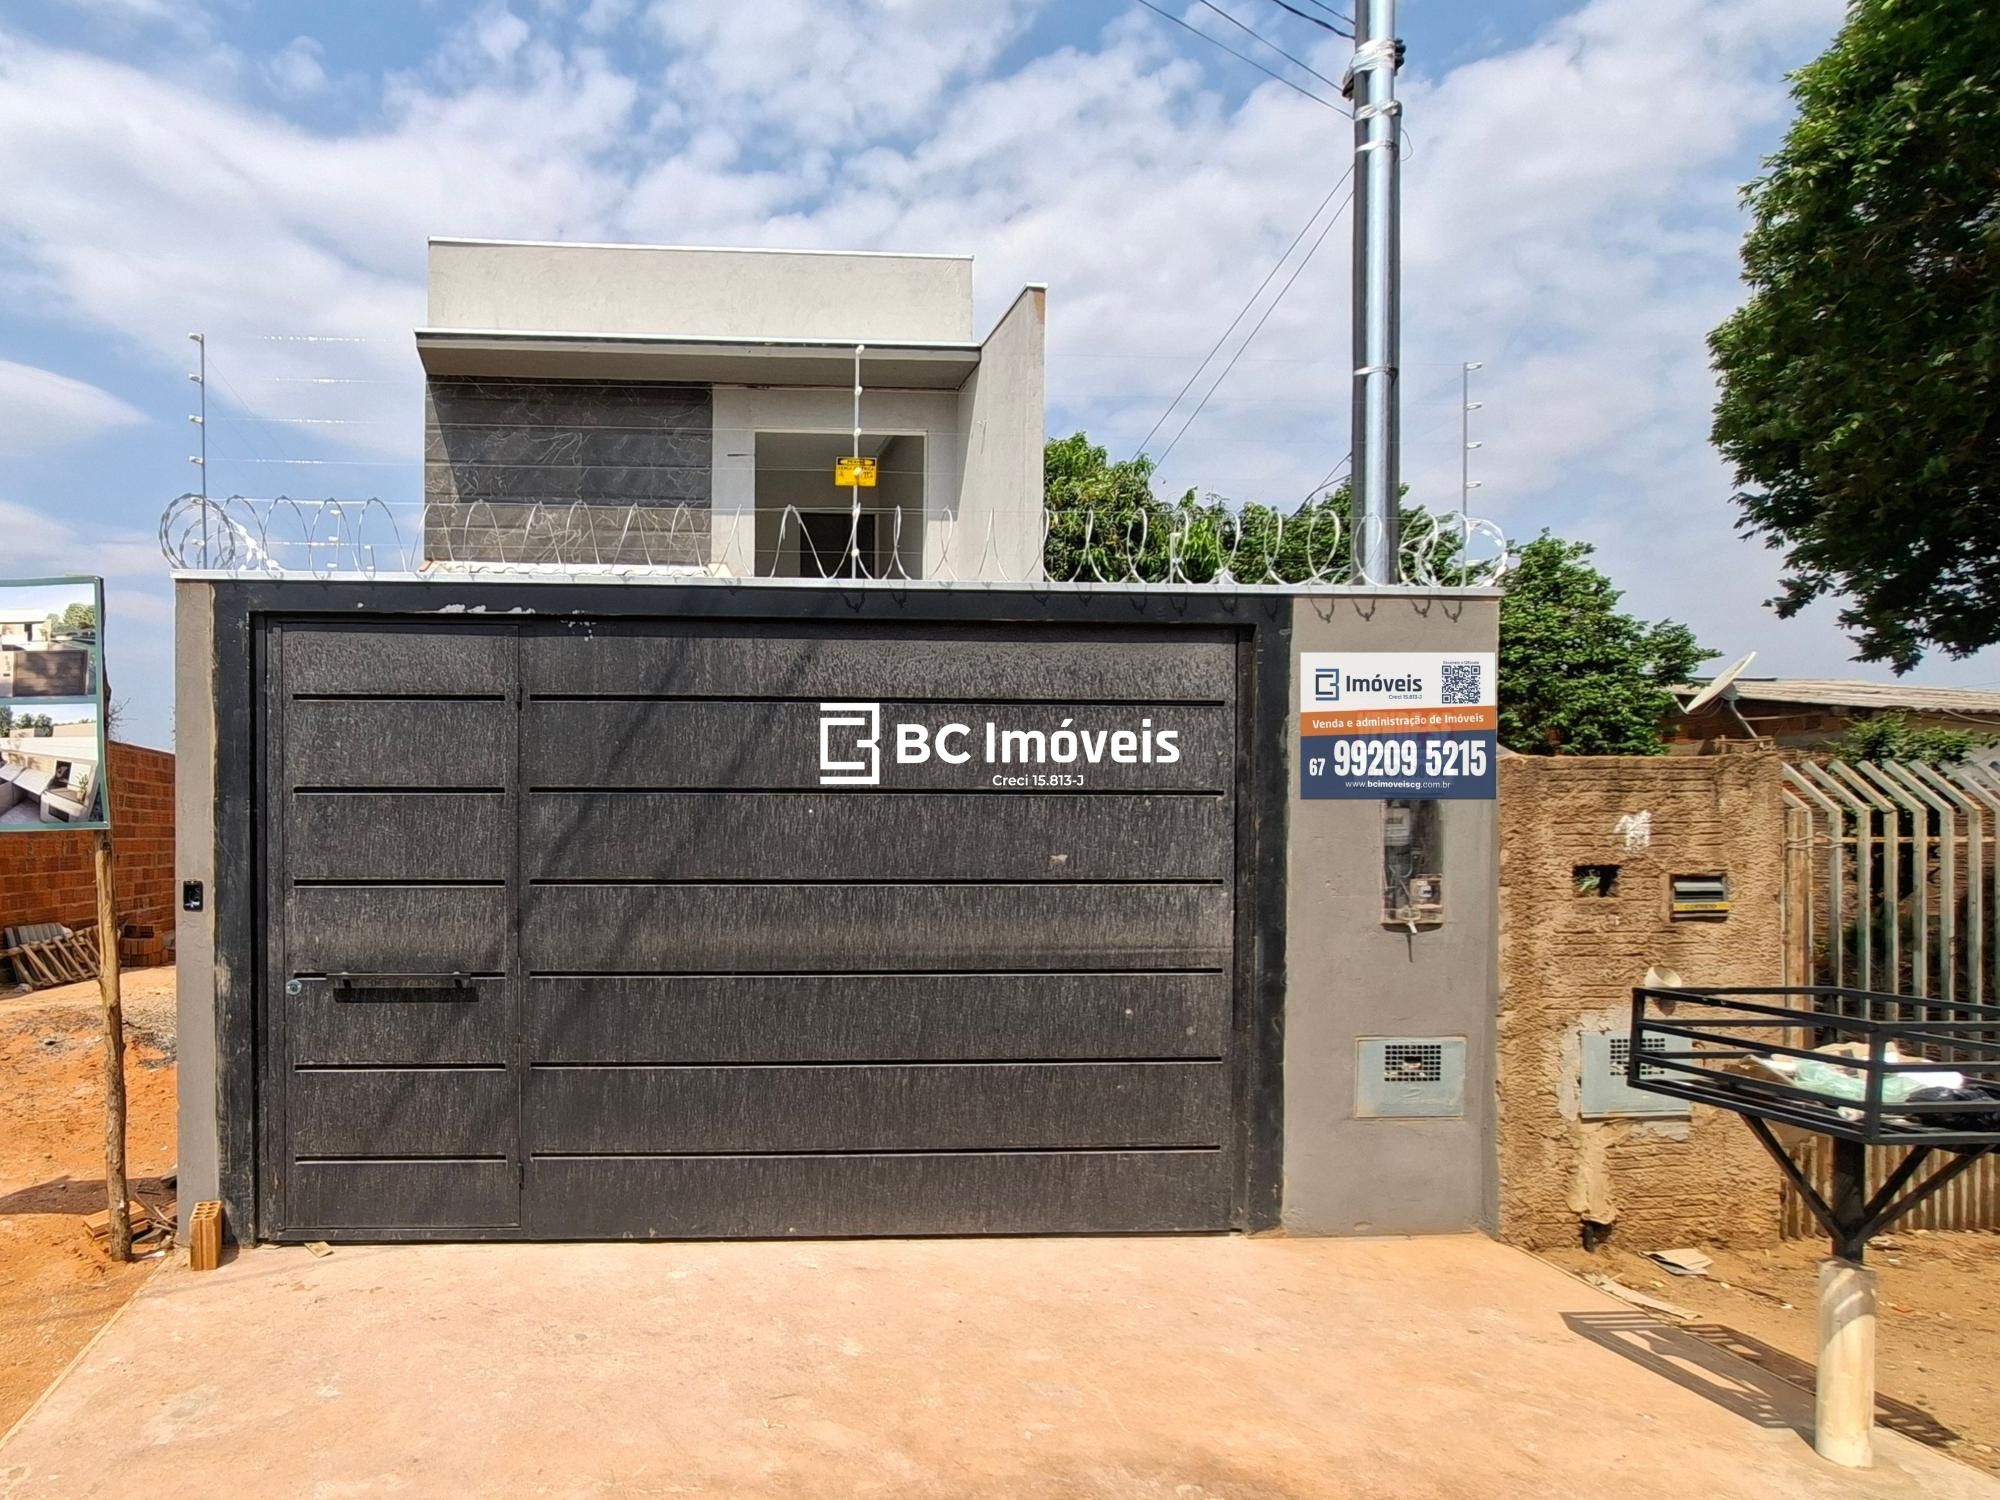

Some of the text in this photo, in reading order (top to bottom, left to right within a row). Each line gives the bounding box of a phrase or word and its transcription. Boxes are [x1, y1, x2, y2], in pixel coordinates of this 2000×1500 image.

[1346, 673, 1423, 692] Imóveis
[1312, 712, 1484, 729] Venda e administração de Imóveis
[1309, 739, 1487, 777] 67 99209 5215
[1345, 780, 1452, 790] www.bcimoveiscg.com.br
